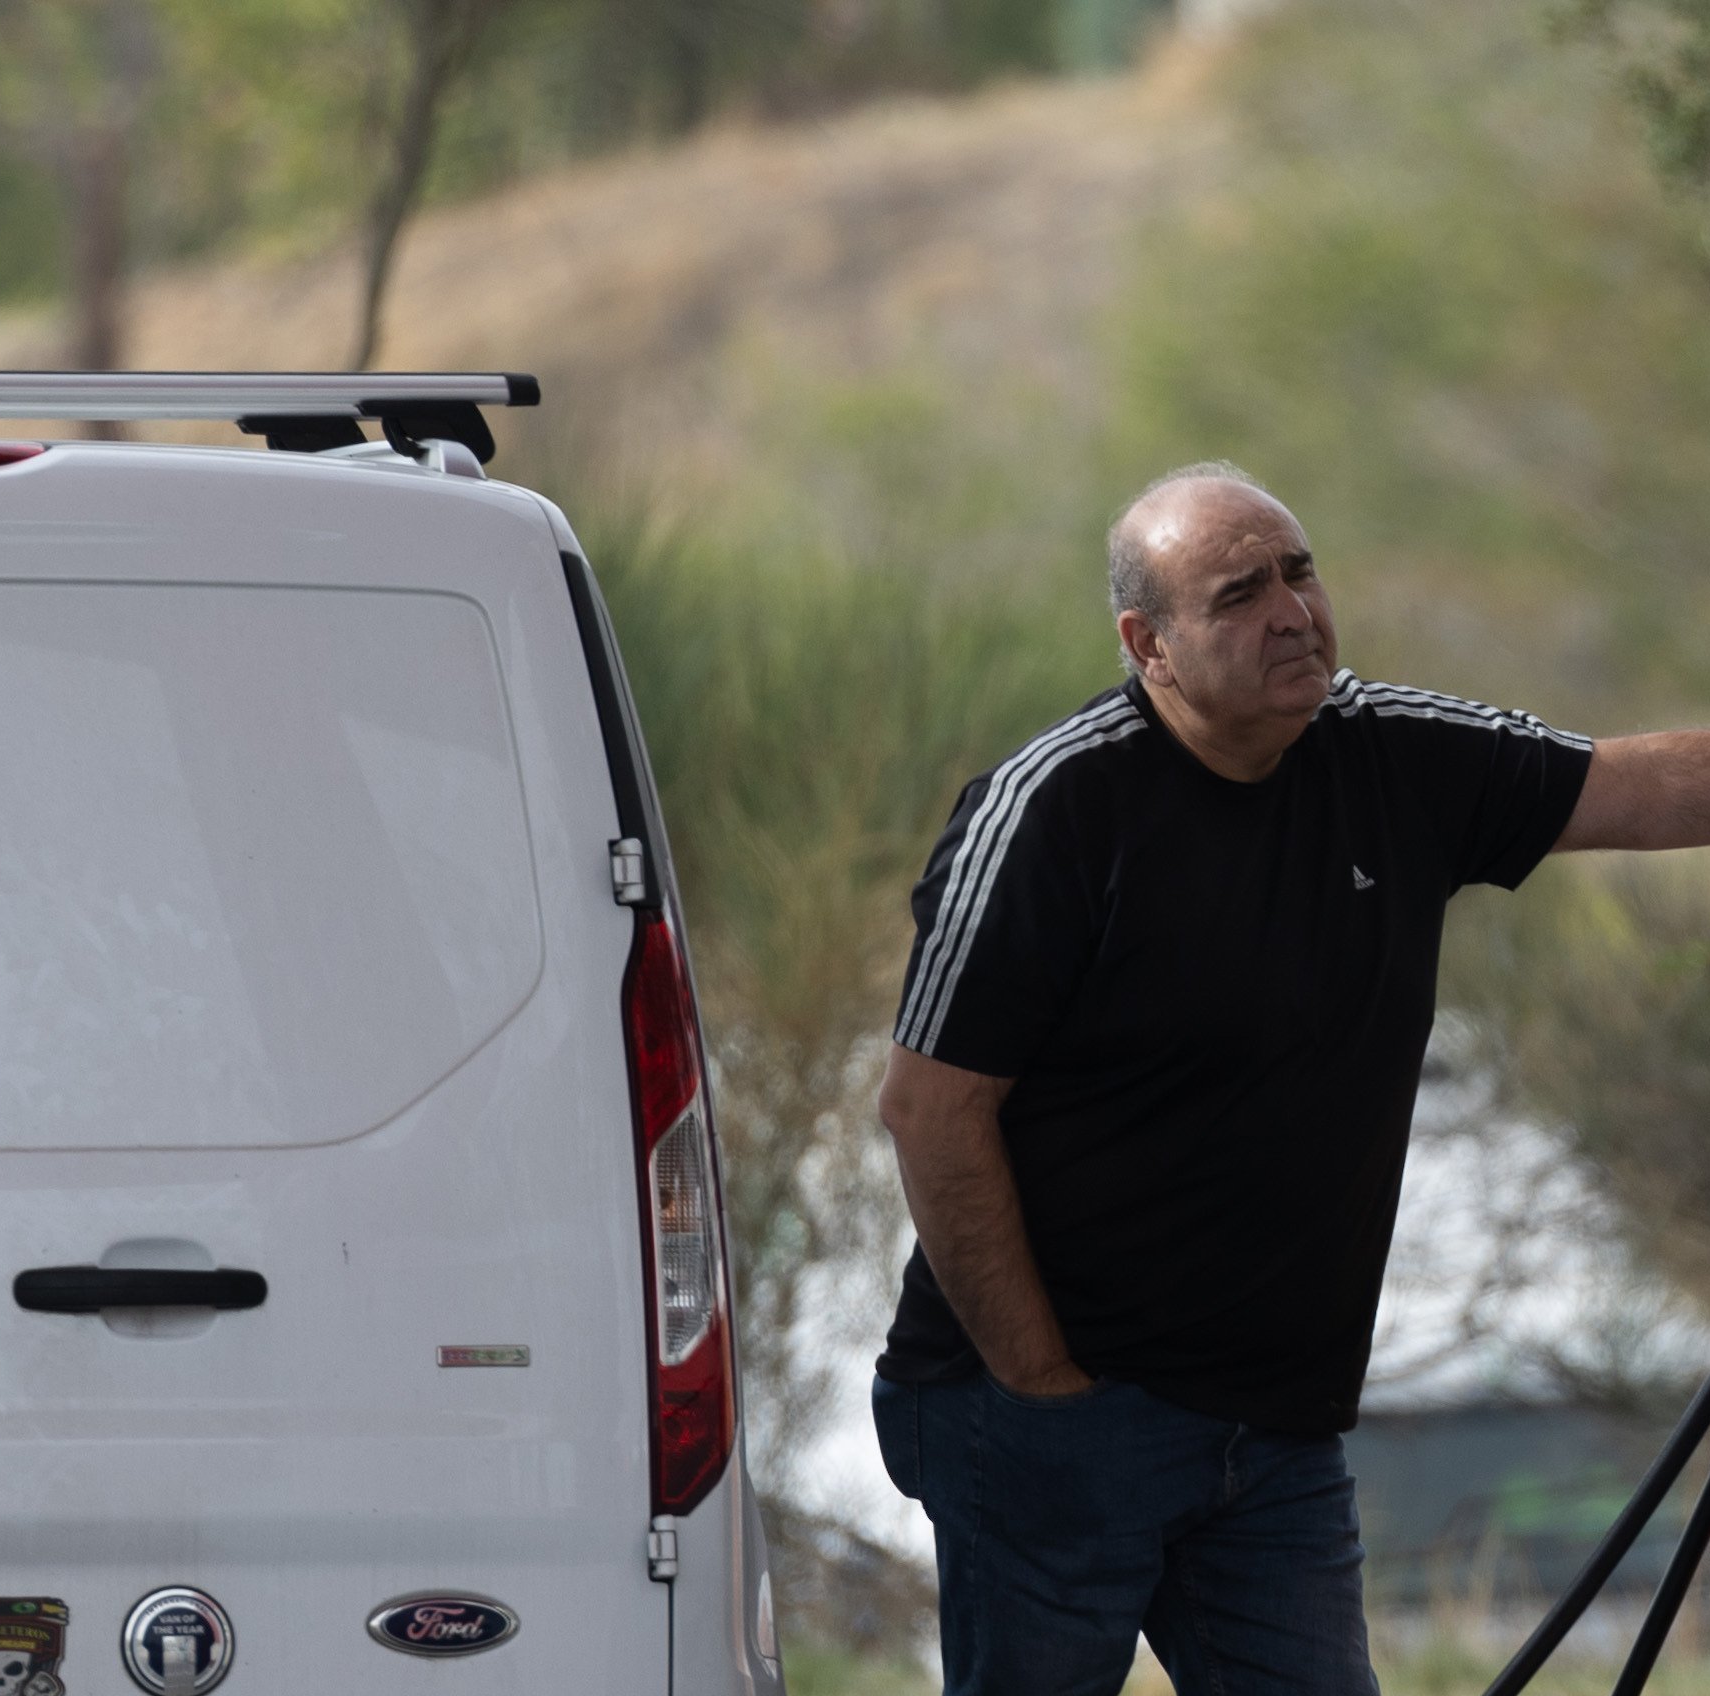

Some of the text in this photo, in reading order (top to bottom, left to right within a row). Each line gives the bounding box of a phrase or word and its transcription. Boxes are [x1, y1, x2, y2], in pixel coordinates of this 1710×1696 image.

[158, 1614, 196, 1623] VAN OF
[406, 1606, 483, 1640] Ford
[152, 1624, 205, 1634] THE YEAR
